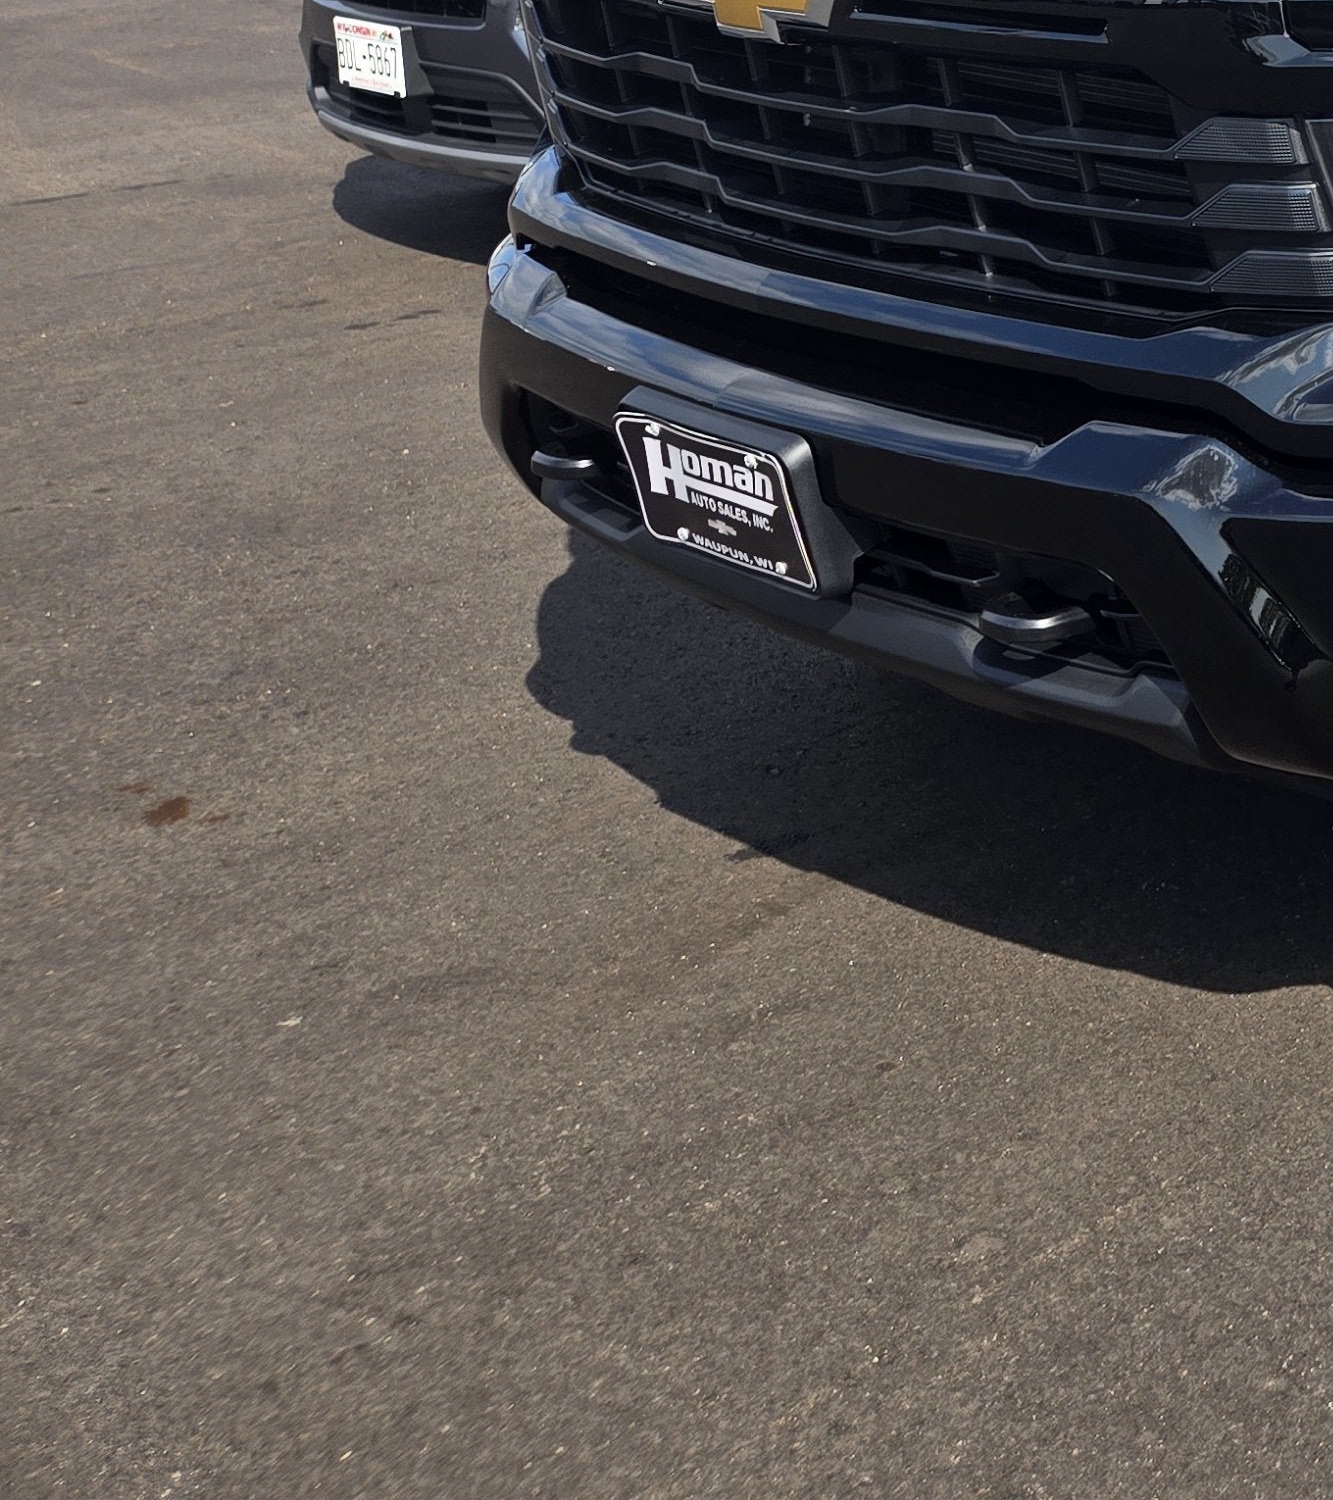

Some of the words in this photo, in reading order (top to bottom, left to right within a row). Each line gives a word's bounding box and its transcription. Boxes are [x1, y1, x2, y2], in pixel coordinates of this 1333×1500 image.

[642, 436, 775, 504] Homan
[690, 491, 717, 513] AUTO
[717, 501, 752, 528] SALES,
[752, 513, 774, 533] INC.
[692, 532, 753, 565] WAUPUN,
[753, 555, 774, 571] WI
